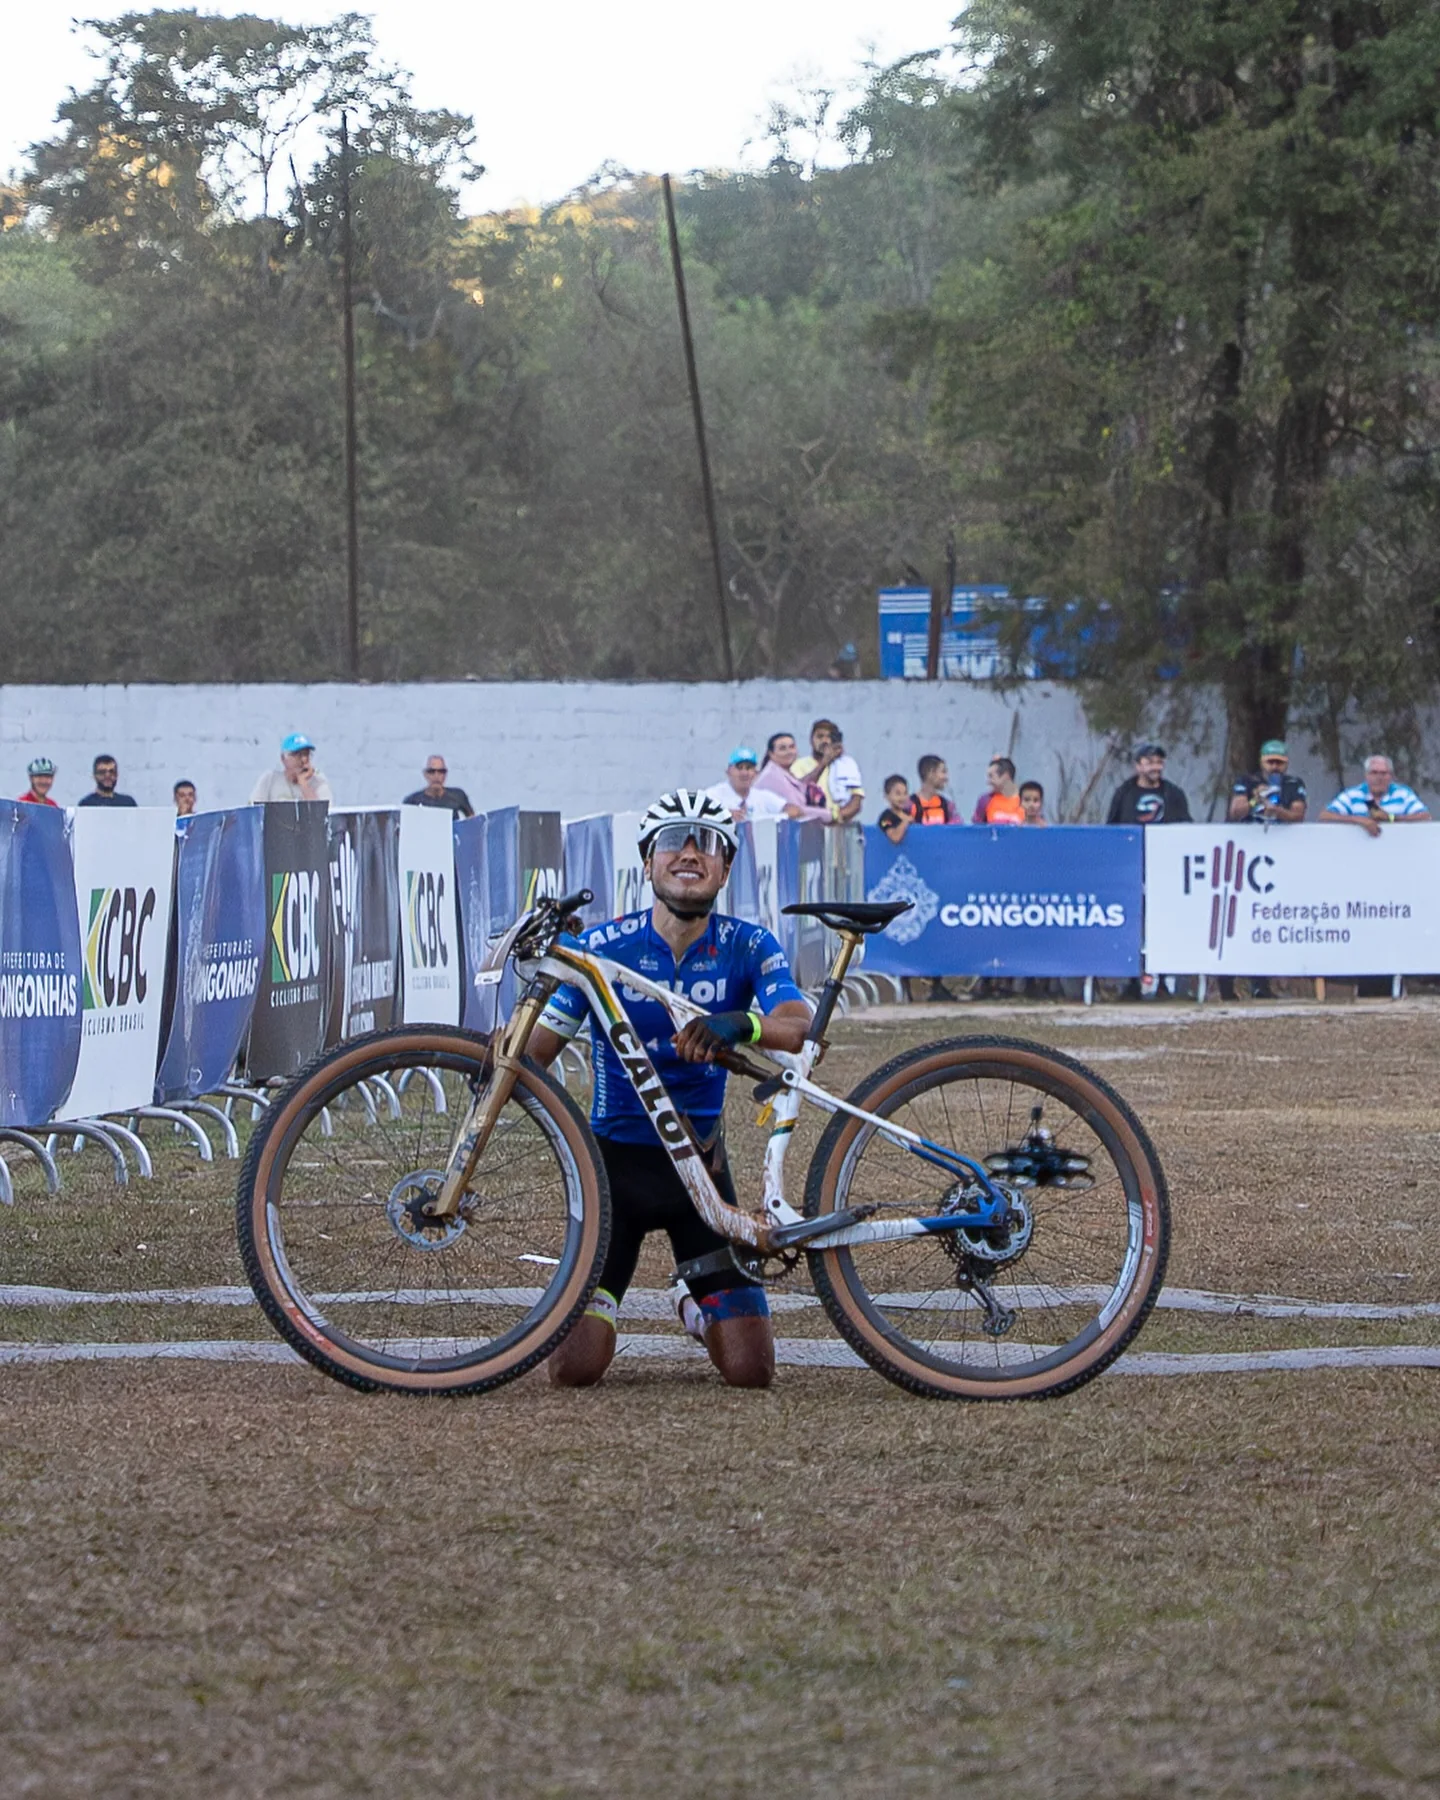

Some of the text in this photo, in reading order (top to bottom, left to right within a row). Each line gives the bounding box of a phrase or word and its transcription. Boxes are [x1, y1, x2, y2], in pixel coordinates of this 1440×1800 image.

[287, 870, 320, 981] CBC
[418, 872, 449, 968] CBC
[579, 912, 648, 951] ALOI
[940, 903, 1125, 928] CONGONHAS
[1251, 901, 1412, 924] Federação Mineira
[104, 887, 156, 1008] CBC
[1251, 926, 1351, 944] de Ciclismo
[54, 952, 65, 970] DE
[190, 956, 259, 1005] NGONHAS
[0, 973, 77, 1018] ONGONHAS
[83, 1014, 116, 1037] ICLISMO
[610, 1021, 698, 1162] CALOI
